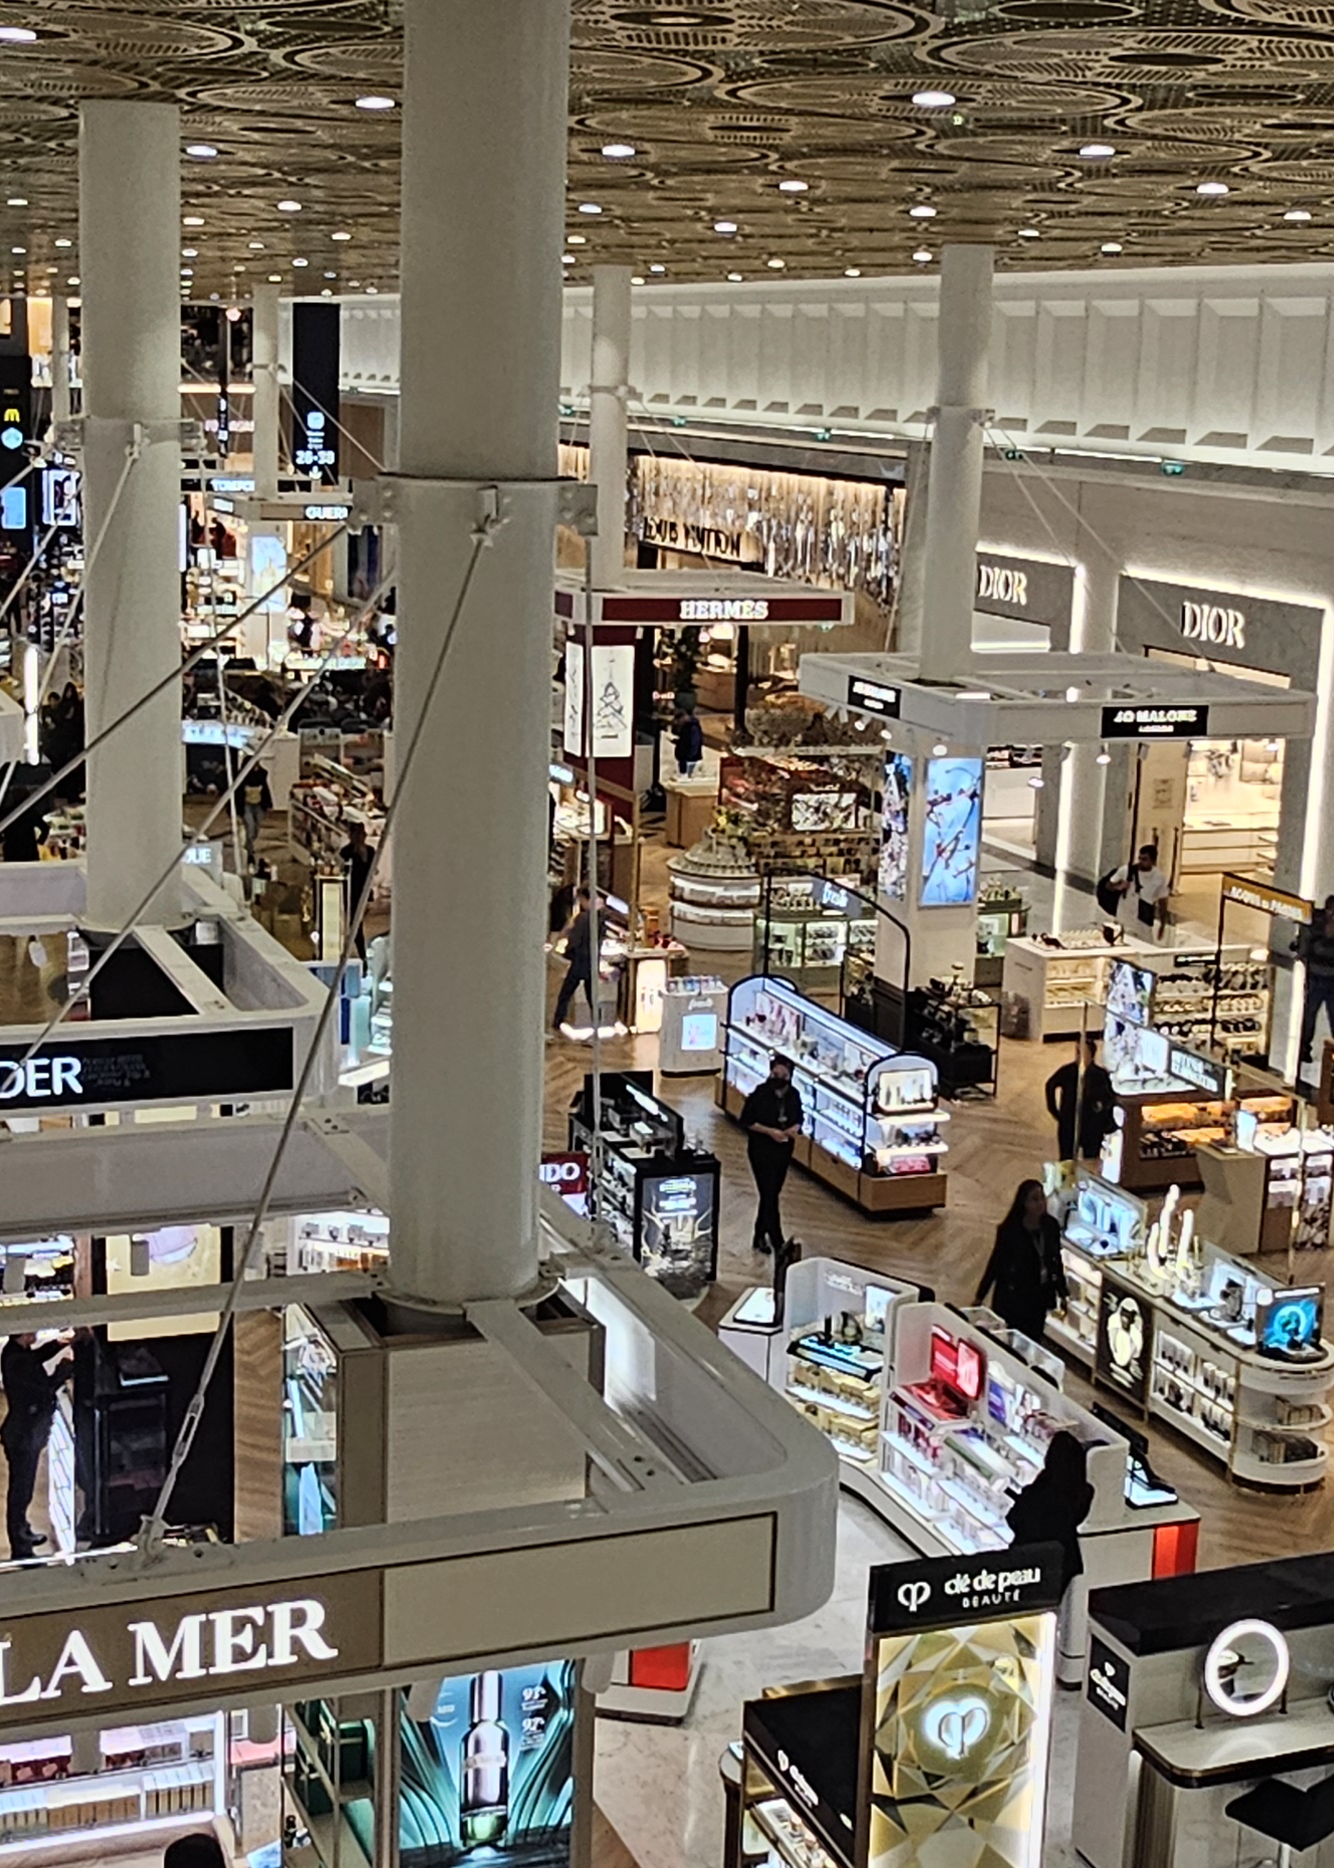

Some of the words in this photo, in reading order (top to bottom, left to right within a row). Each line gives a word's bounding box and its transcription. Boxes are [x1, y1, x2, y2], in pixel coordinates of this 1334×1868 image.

[977, 564, 1028, 606] DIOR
[1181, 599, 1246, 649] DIOR
[539, 1161, 580, 1182] IDO
[943, 1573, 971, 1595] clé
[972, 1568, 996, 1592] de
[998, 1566, 1042, 1593] peau
[126, 1598, 339, 1687] MER
